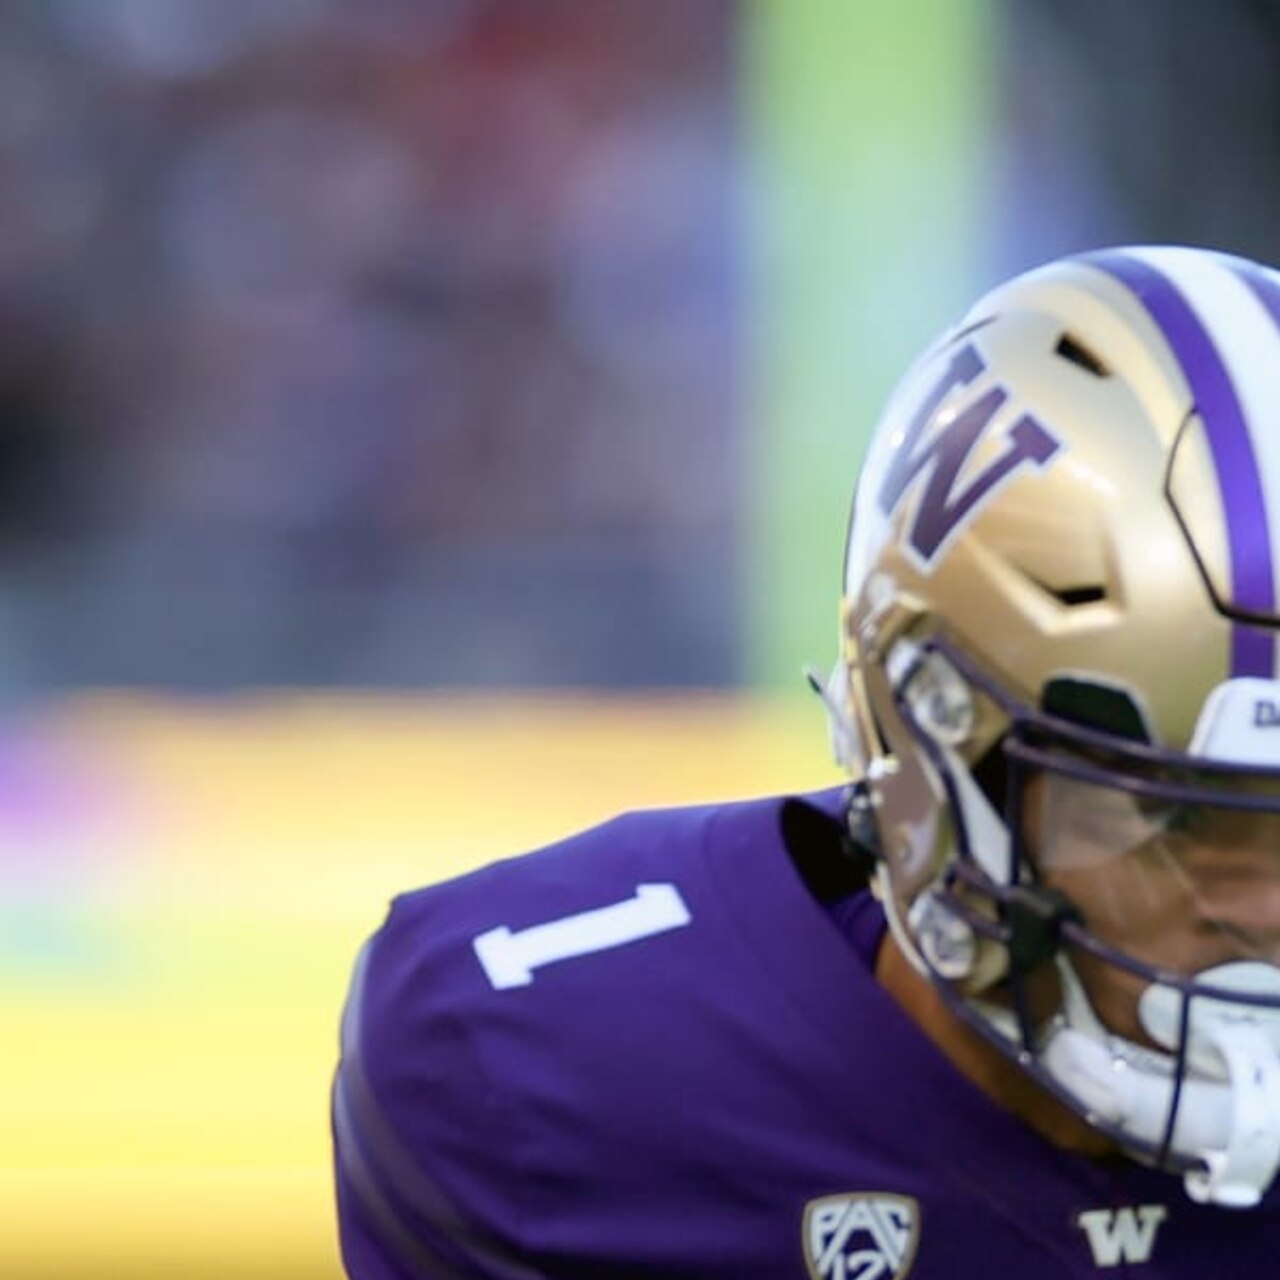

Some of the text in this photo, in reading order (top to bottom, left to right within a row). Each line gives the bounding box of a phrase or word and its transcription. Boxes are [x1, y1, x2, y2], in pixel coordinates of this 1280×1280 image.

[874, 340, 1062, 564] W
[472, 882, 692, 990] 1
[1078, 1205, 1167, 1267] W
